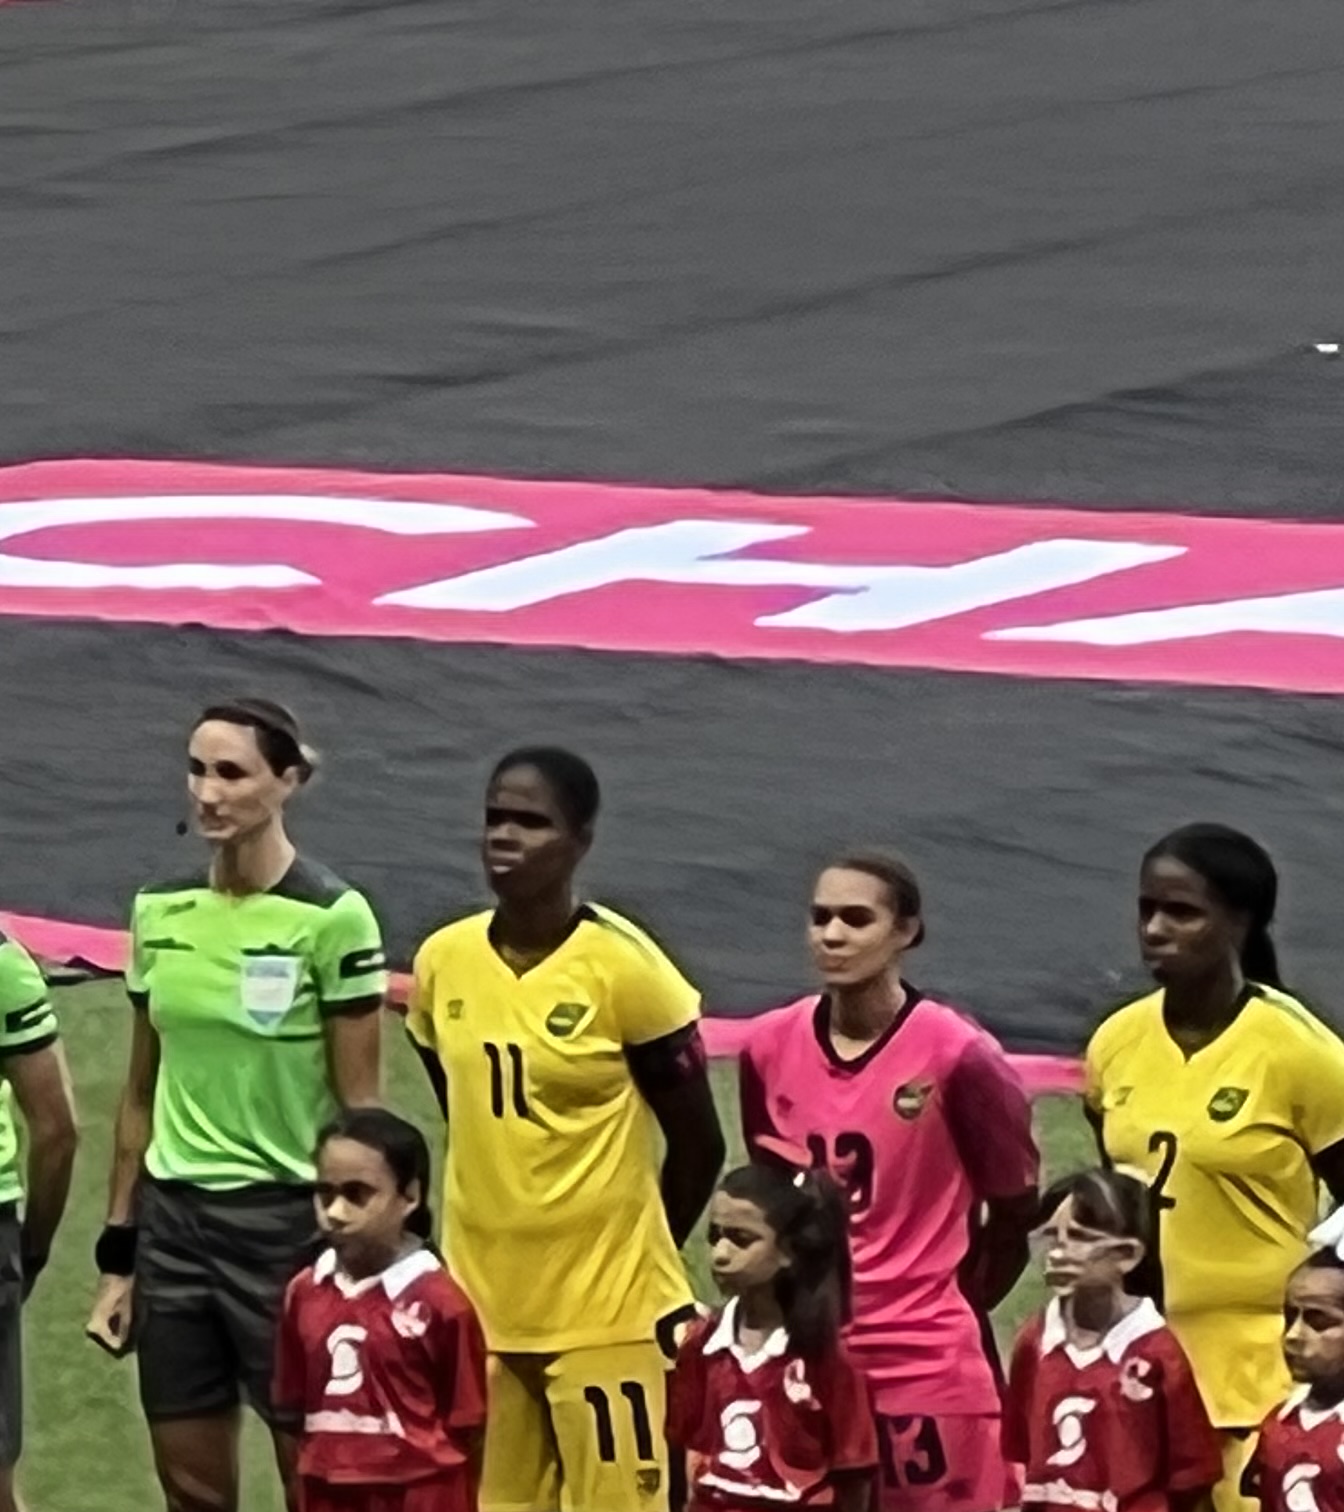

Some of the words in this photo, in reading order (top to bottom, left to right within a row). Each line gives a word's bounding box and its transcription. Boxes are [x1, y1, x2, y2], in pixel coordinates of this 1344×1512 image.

[481, 1041, 533, 1119] 11
[1147, 1131, 1178, 1210] 2
[582, 1380, 655, 1463] 11
